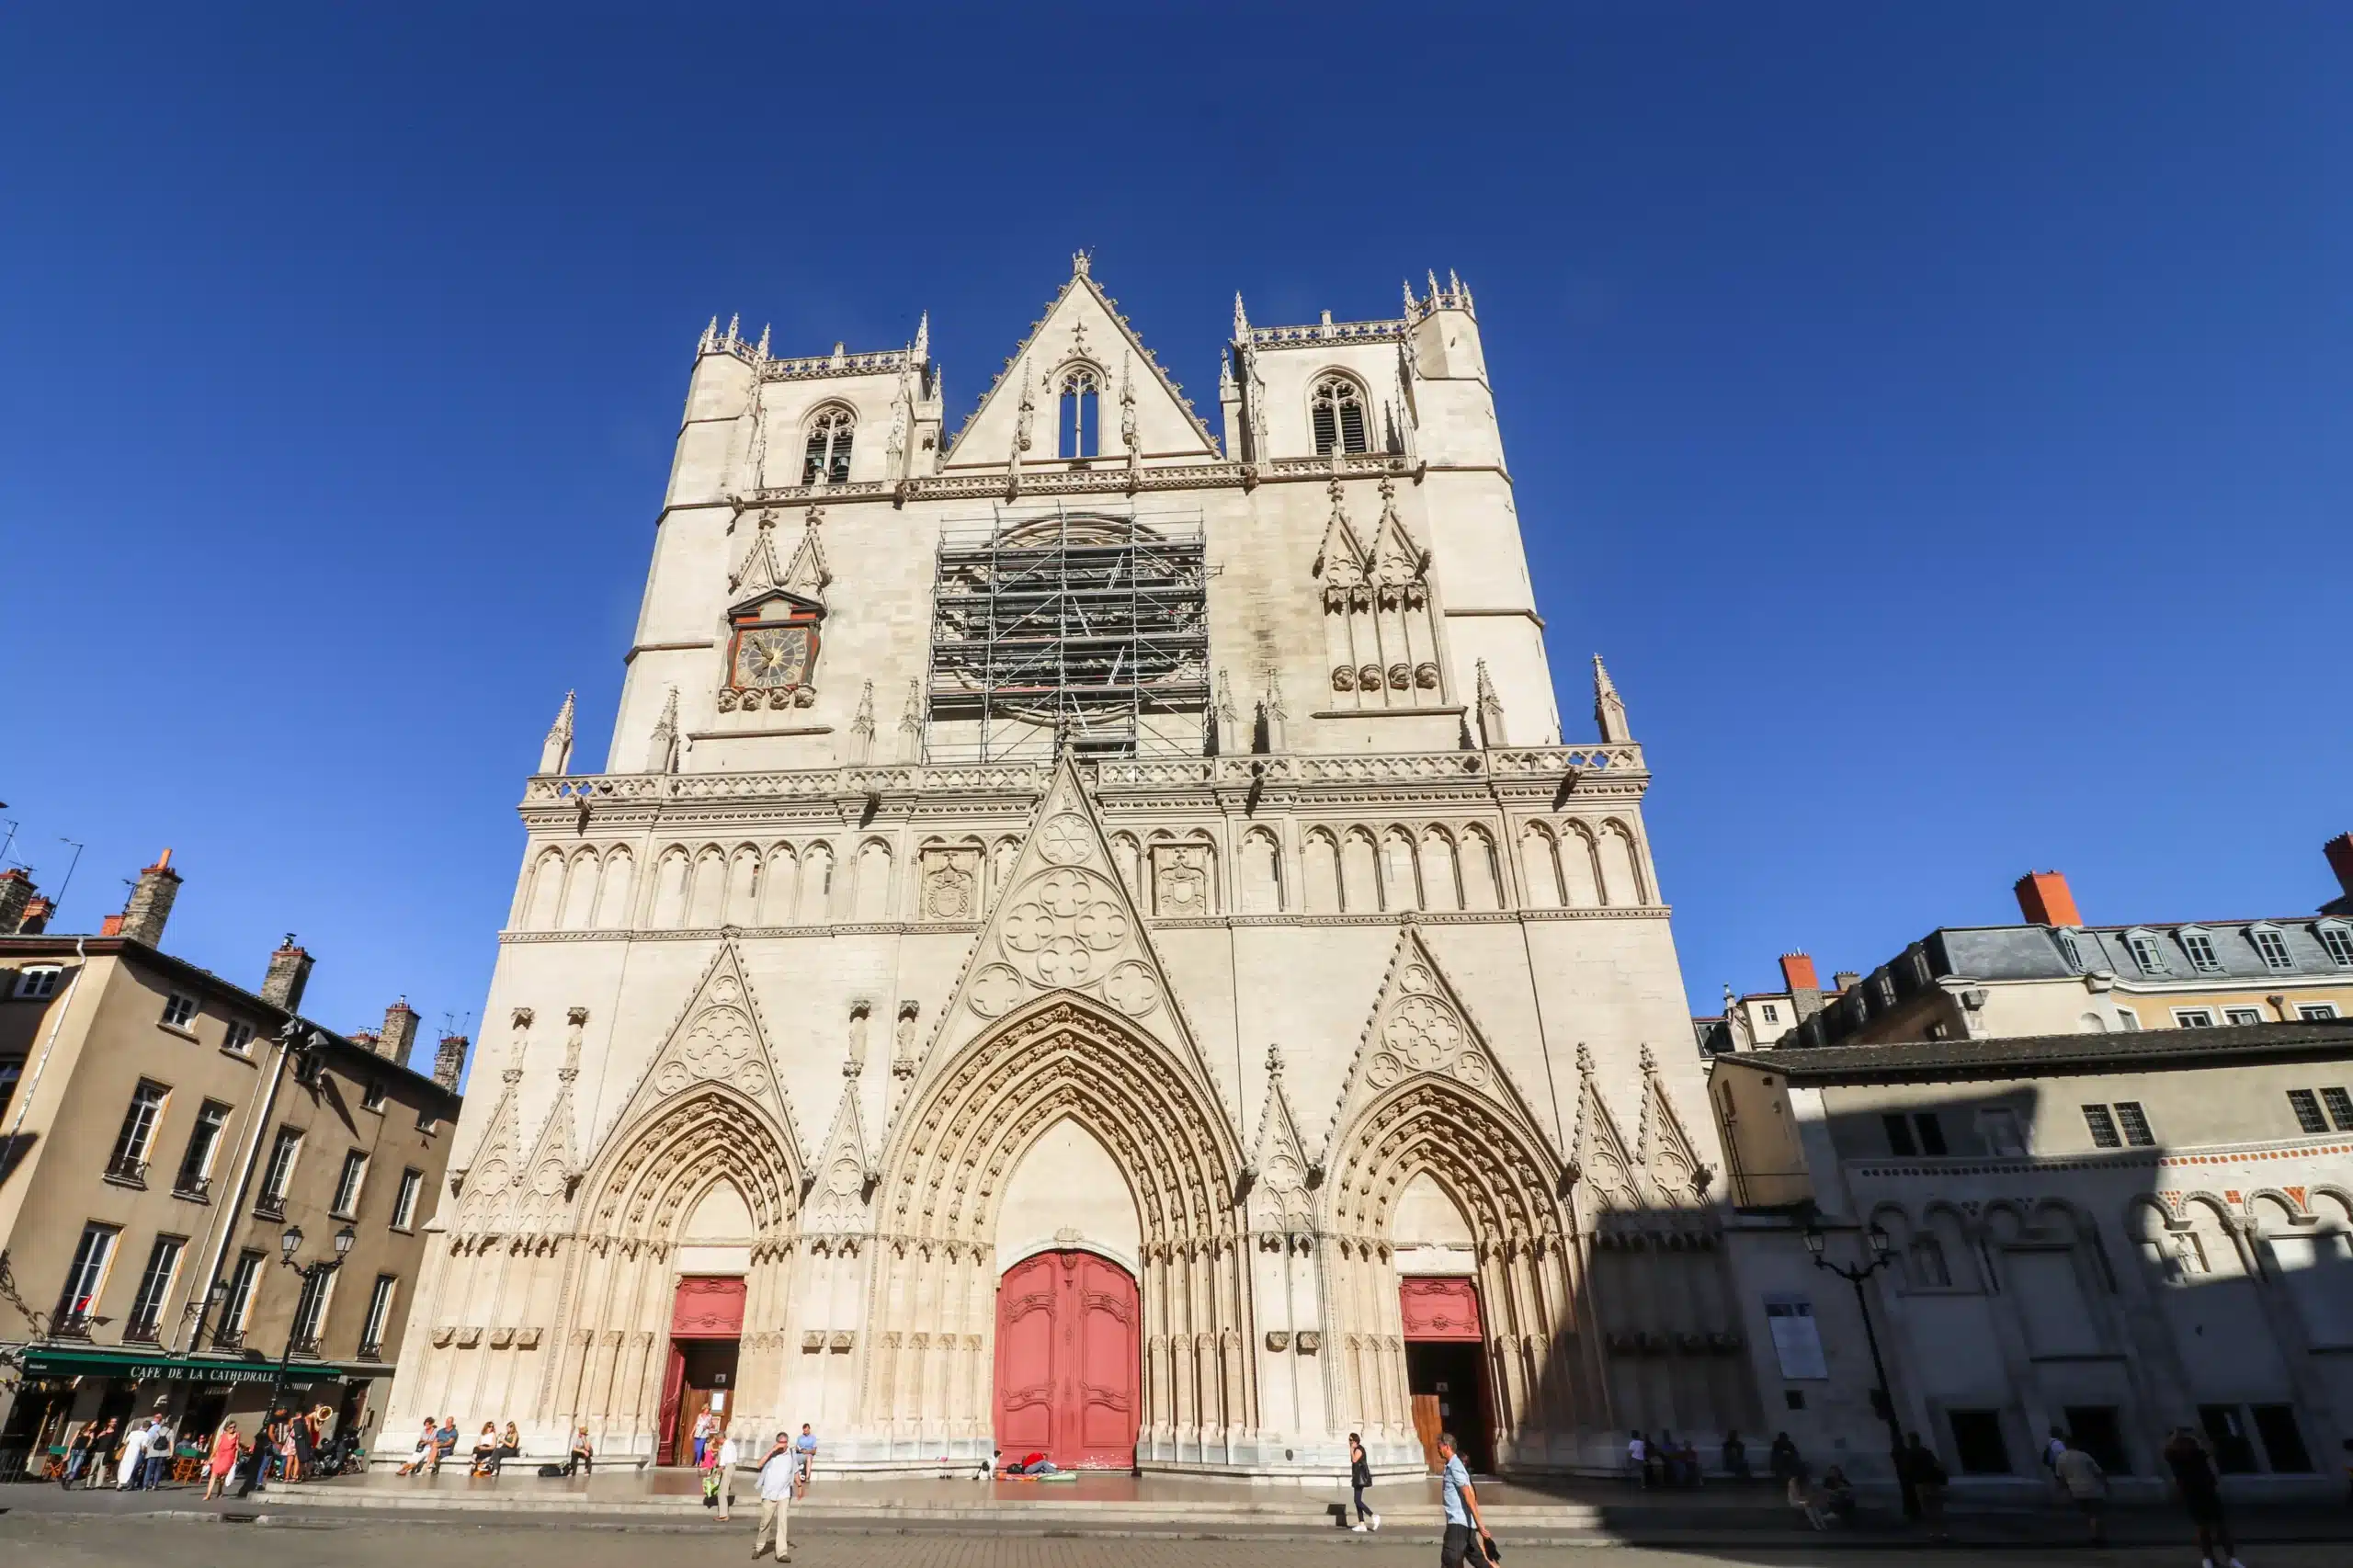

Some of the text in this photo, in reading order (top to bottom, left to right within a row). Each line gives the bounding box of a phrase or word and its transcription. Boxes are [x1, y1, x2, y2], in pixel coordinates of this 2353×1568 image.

[131, 1366, 275, 1382] CAFE DE LA CATHEDRALE
